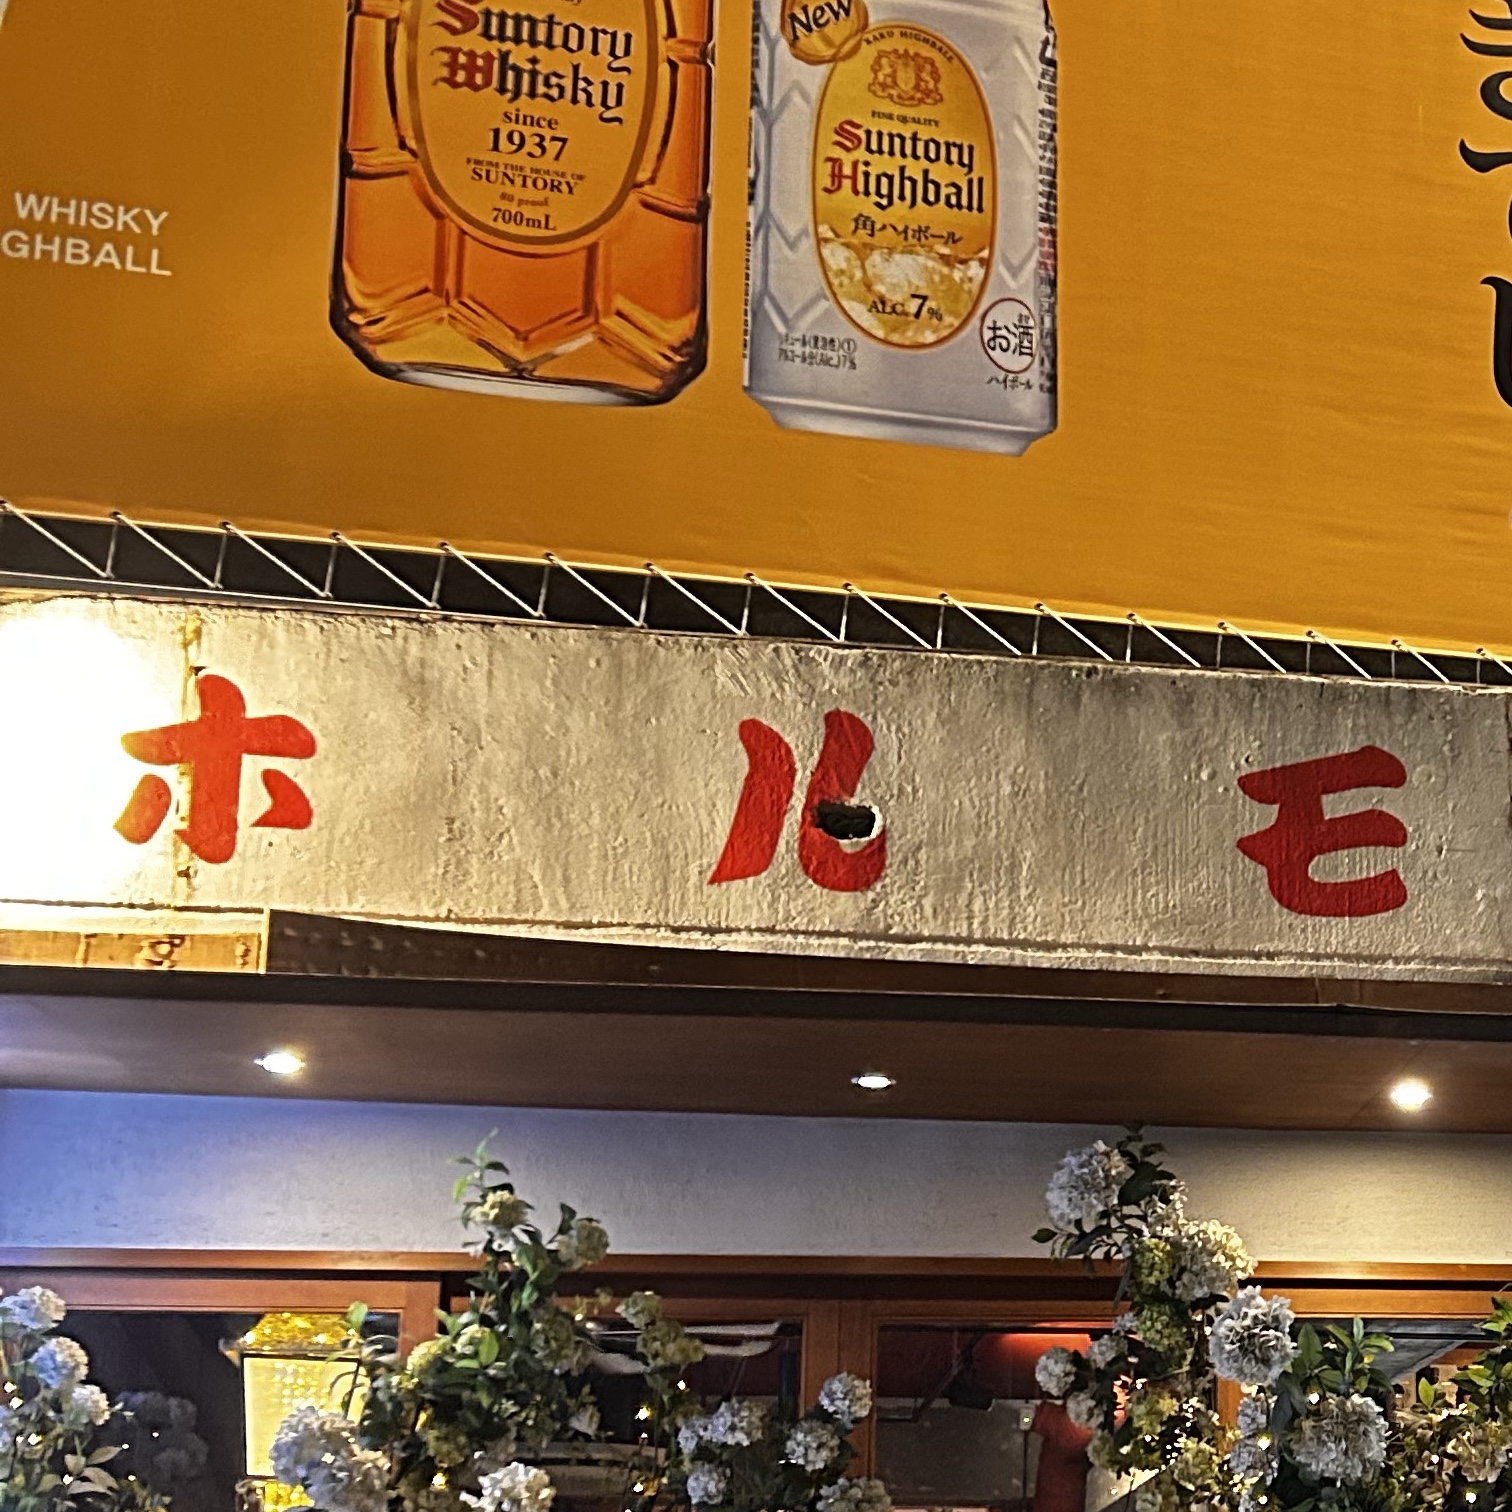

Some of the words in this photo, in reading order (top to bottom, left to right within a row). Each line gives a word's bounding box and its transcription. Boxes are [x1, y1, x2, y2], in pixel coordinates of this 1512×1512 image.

[427, 0, 633, 75] Suntory
[787, 0, 852, 43] New
[430, 46, 625, 125] Whisky
[502, 107, 559, 131] since
[487, 127, 569, 161] 1937
[831, 119, 975, 176] Suntory
[471, 166, 576, 195] SUNTORY
[822, 156, 984, 214] Highball
[14, 191, 169, 236] WHISKY
[491, 207, 557, 231] 700mL
[851, 212, 964, 245] 角ハイボール
[0, 229, 172, 276] GHBALL
